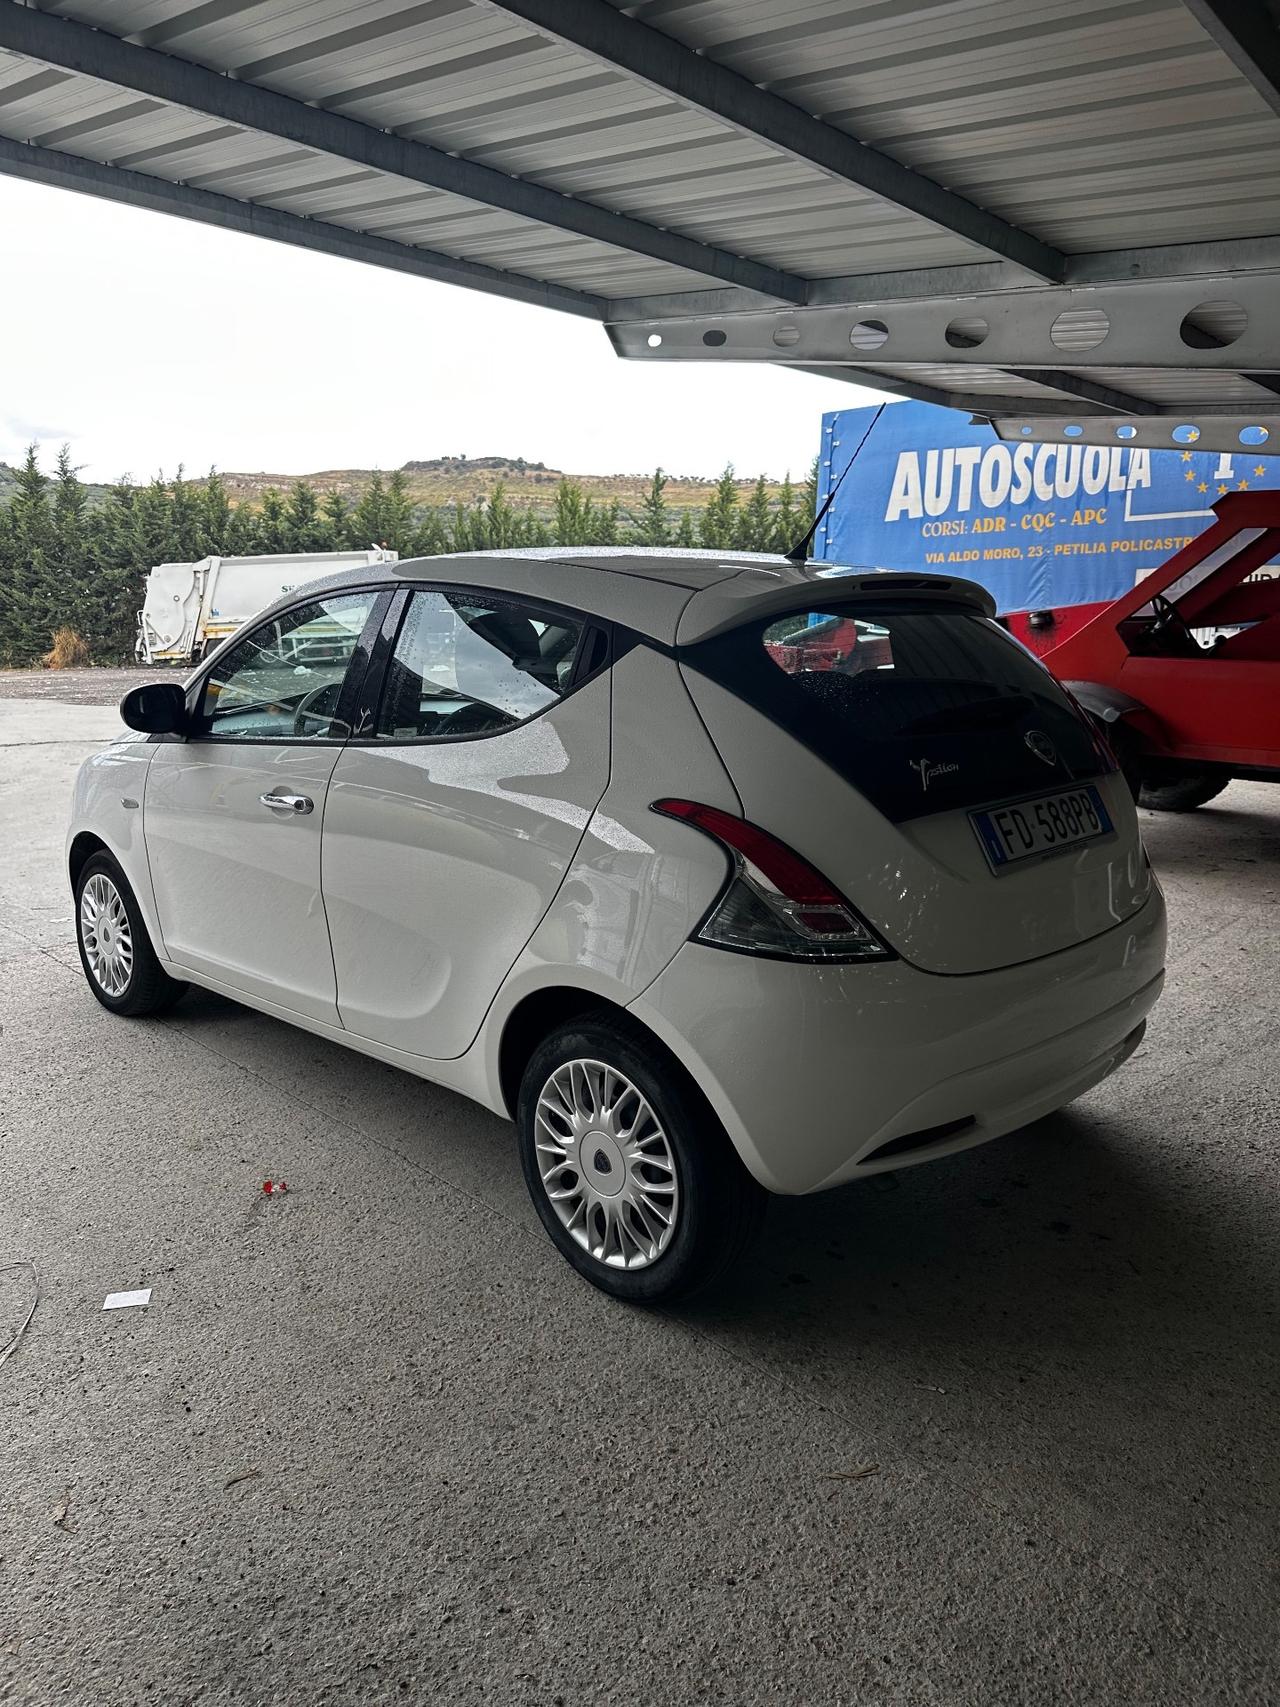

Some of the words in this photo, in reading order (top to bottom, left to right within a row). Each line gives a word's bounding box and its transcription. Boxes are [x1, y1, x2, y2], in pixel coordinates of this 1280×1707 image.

[884, 442, 1151, 522] AUTOSCUOLA
[922, 520, 968, 538] CORSI:
[972, 516, 1006, 533] ADR
[1021, 512, 1056, 532] CQC
[1070, 508, 1107, 526] APC
[925, 553, 945, 564] VIA
[948, 550, 980, 563] ALDO
[983, 548, 1024, 560] MORO,
[1028, 545, 1043, 557] 23
[1054, 542, 1107, 556] PETILIA
[1111, 536, 1194, 553] POLICASTR
